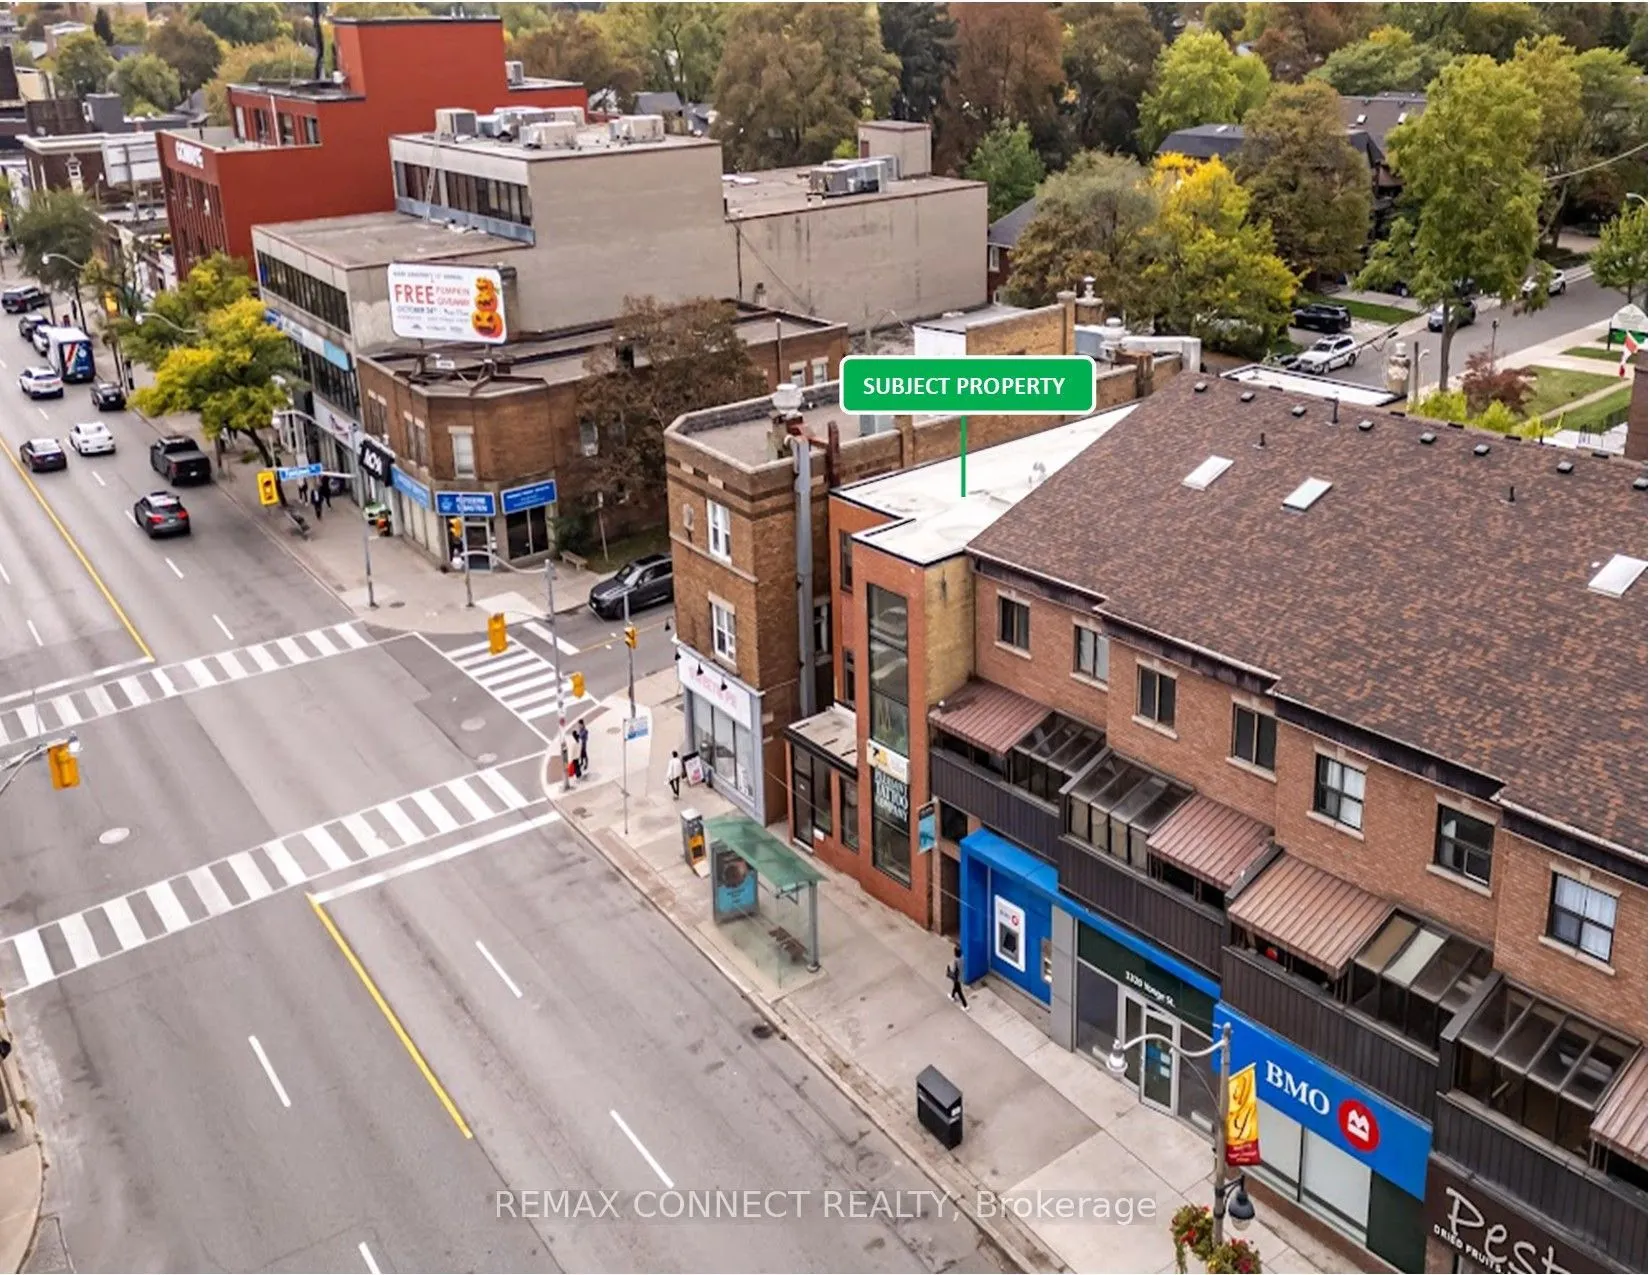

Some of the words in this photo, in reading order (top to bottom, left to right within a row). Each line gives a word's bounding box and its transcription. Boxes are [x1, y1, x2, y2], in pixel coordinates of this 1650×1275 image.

[394, 284, 435, 304] FREE
[436, 286, 470, 296] PUMPKIN
[876, 781, 909, 809] TATTOO
[1144, 981, 1165, 1003] Yonge
[1266, 1060, 1330, 1115] BMO
[1433, 1223, 1463, 1249] DRIED
